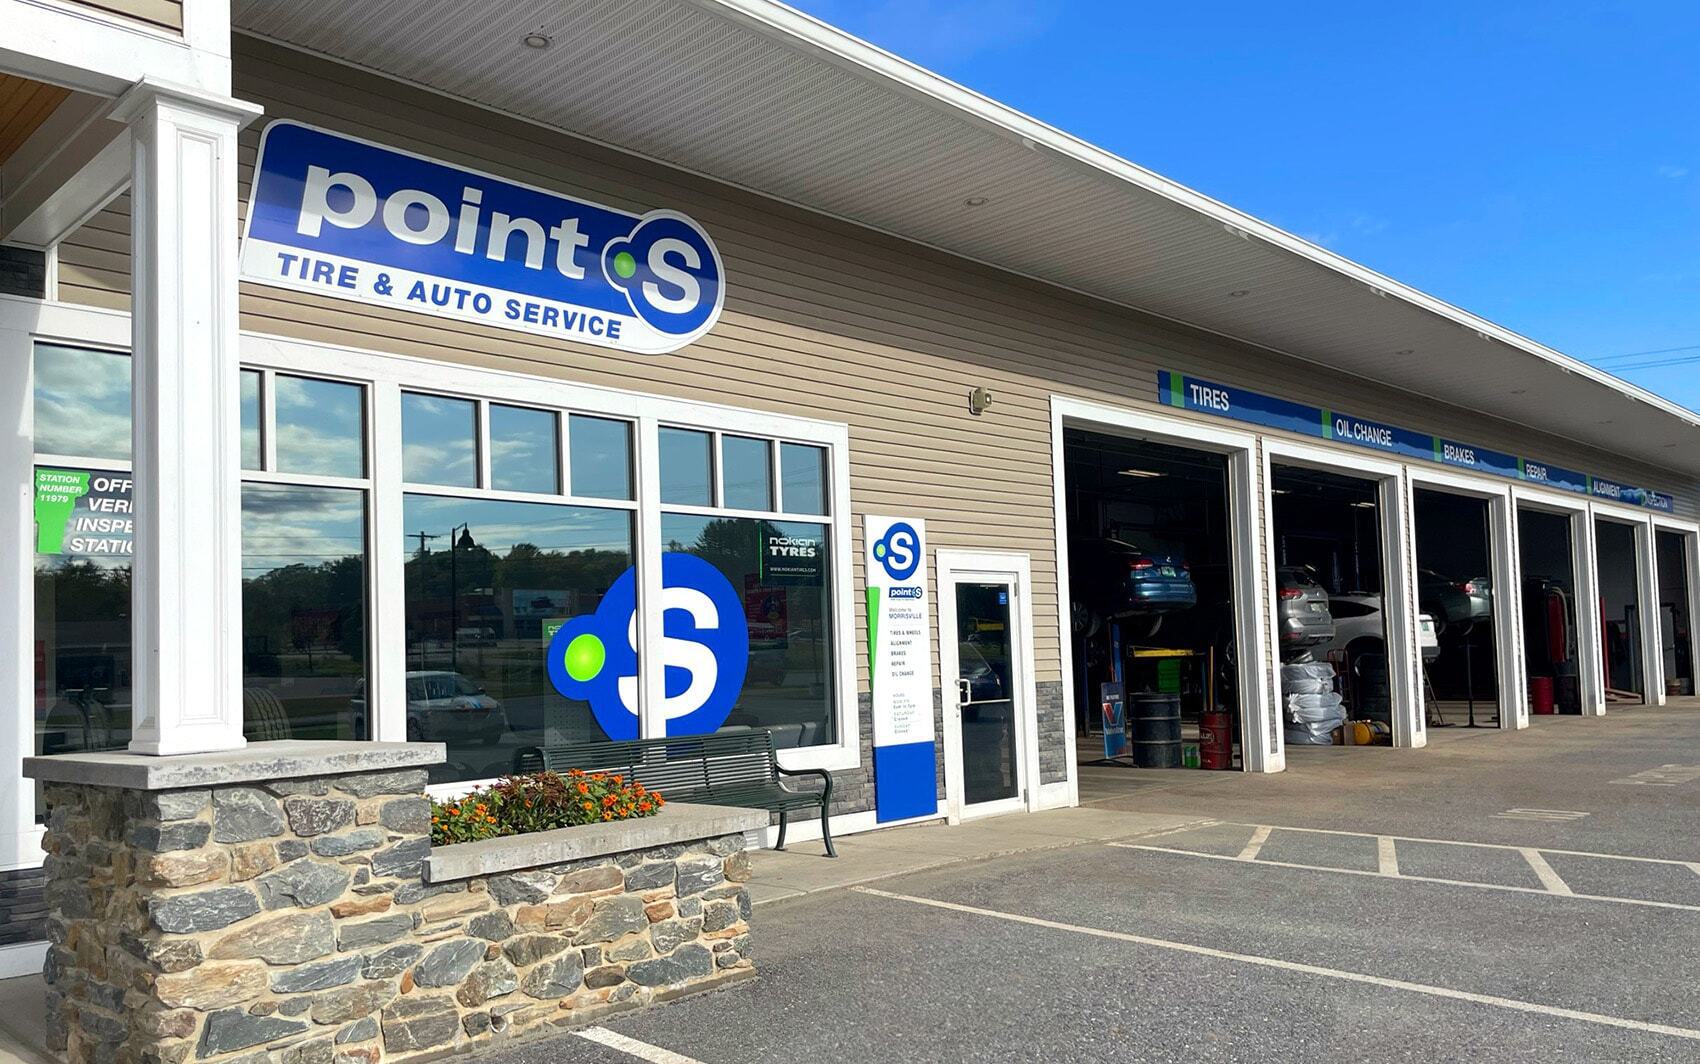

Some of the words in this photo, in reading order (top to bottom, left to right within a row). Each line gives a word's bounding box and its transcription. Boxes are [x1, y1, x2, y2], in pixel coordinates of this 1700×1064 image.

[296, 165, 589, 279] point
[277, 252, 358, 290] TIRE
[373, 273, 394, 296] &
[407, 281, 492, 314] AUTO
[504, 299, 622, 339] SERVICE
[1190, 384, 1230, 411] TIRES
[1336, 418, 1353, 439] OIL
[1353, 423, 1393, 447] CHANGE
[1443, 444, 1475, 465] BRAKES
[40, 474, 80, 484] STATION
[1525, 464, 1548, 480] REPAIR
[40, 484, 82, 494] NUMBER
[40, 494, 69, 503] 11979
[769, 546, 816, 558] TYRES
[891, 588, 912, 597] point
